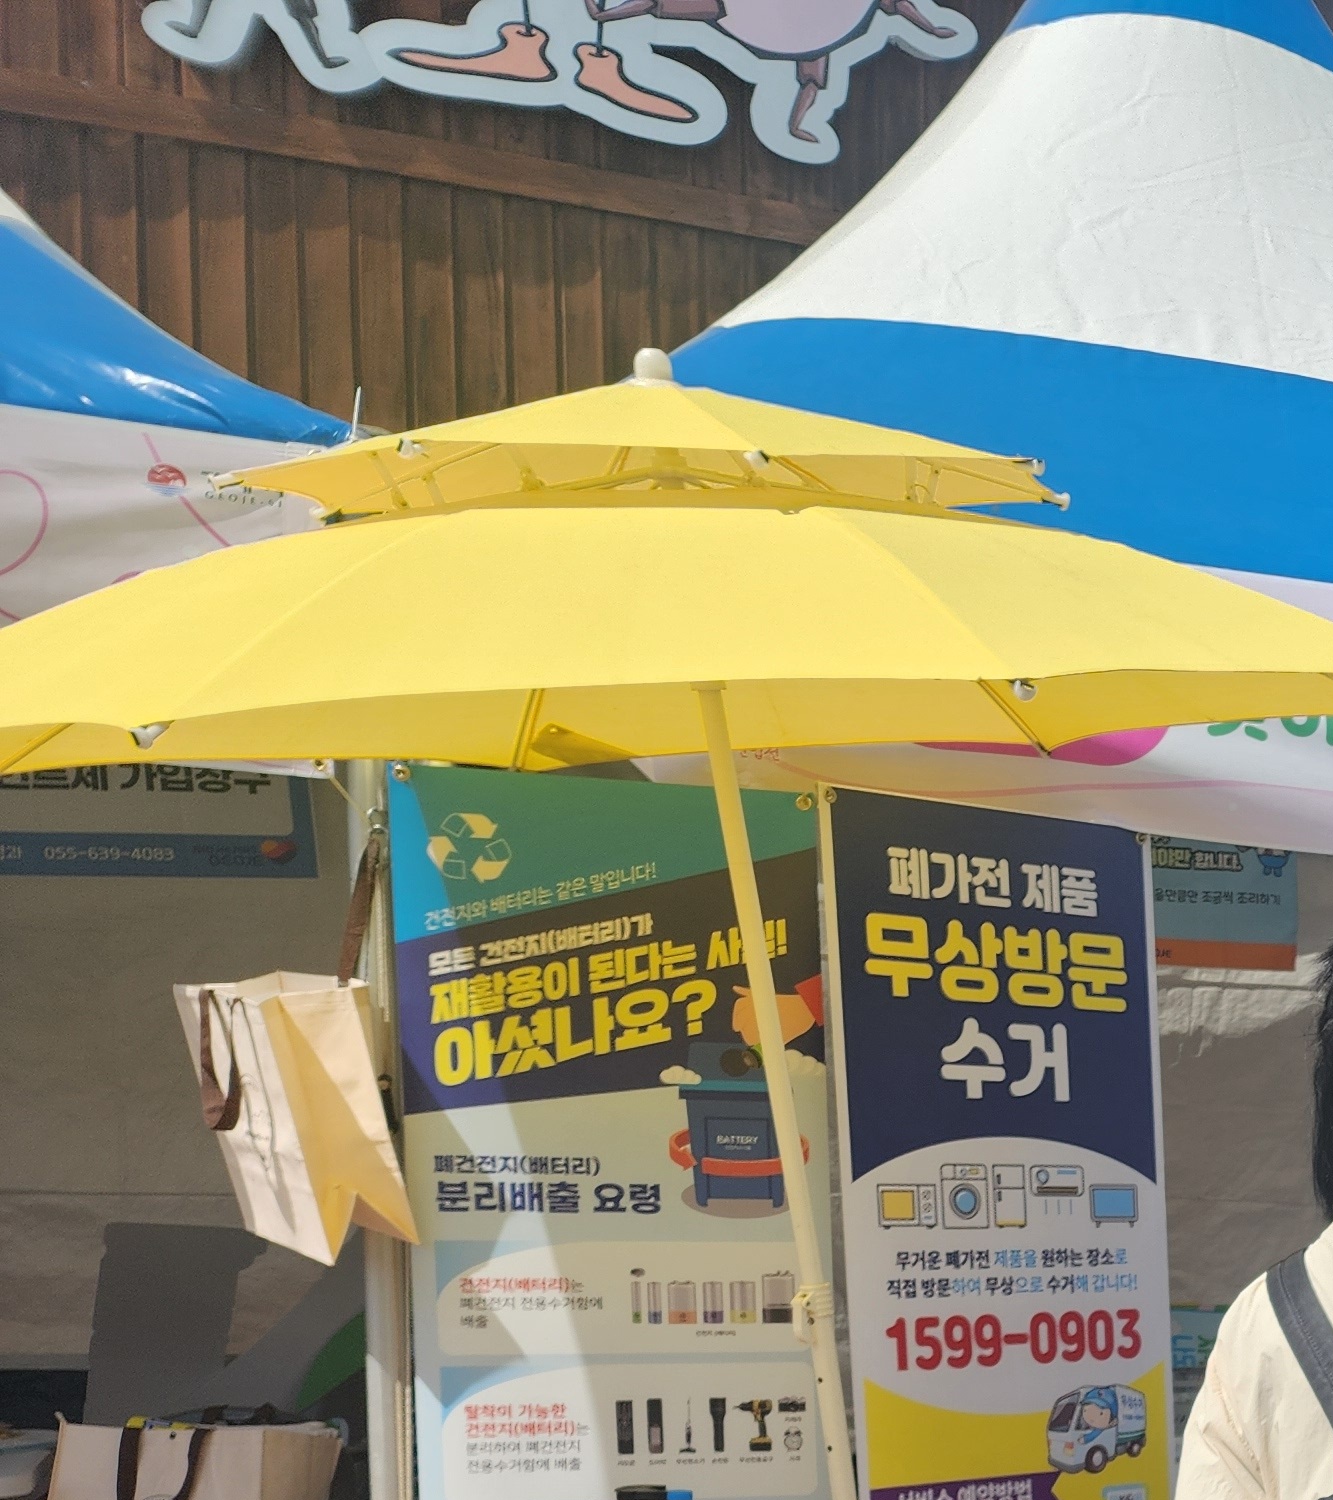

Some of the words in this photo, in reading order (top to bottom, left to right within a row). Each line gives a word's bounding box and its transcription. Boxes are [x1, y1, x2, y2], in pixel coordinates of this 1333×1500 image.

[489, 887, 554, 914] 배터리는
[556, 874, 588, 899] 같은
[886, 846, 1013, 909] 폐가전
[1020, 861, 1099, 918] 제품
[427, 946, 477, 977] 모든
[479, 912, 655, 968] 건전지(배터리)가
[864, 911, 1128, 1014] 무상방문
[429, 956, 582, 1025] 재활용이
[588, 939, 698, 994] 된다는
[433, 978, 718, 1087] 아셨나요?
[940, 1016, 1071, 1103] 수거
[433, 1153, 601, 1177] 폐건전지(배터리)
[716, 1134, 760, 1146] BATTERY
[435, 1180, 581, 1214] 분리배출
[591, 1182, 663, 1215] 요령
[895, 1250, 943, 1273] 무거운
[945, 1248, 991, 1270] 폐가전
[993, 1247, 1037, 1269] 제품을
[1041, 1247, 1085, 1269] 원하는
[1086, 1246, 1129, 1267] 장소로
[886, 1278, 918, 1300] 직접
[921, 1275, 982, 1299] 방문하여
[985, 1274, 1044, 1297] 무상으로
[1046, 1273, 1089, 1296] 수거해
[1091, 1272, 1139, 1294] 갑니다!
[885, 1308, 1143, 1372] 1599-0903
[518, 1402, 568, 1419] 가능한
